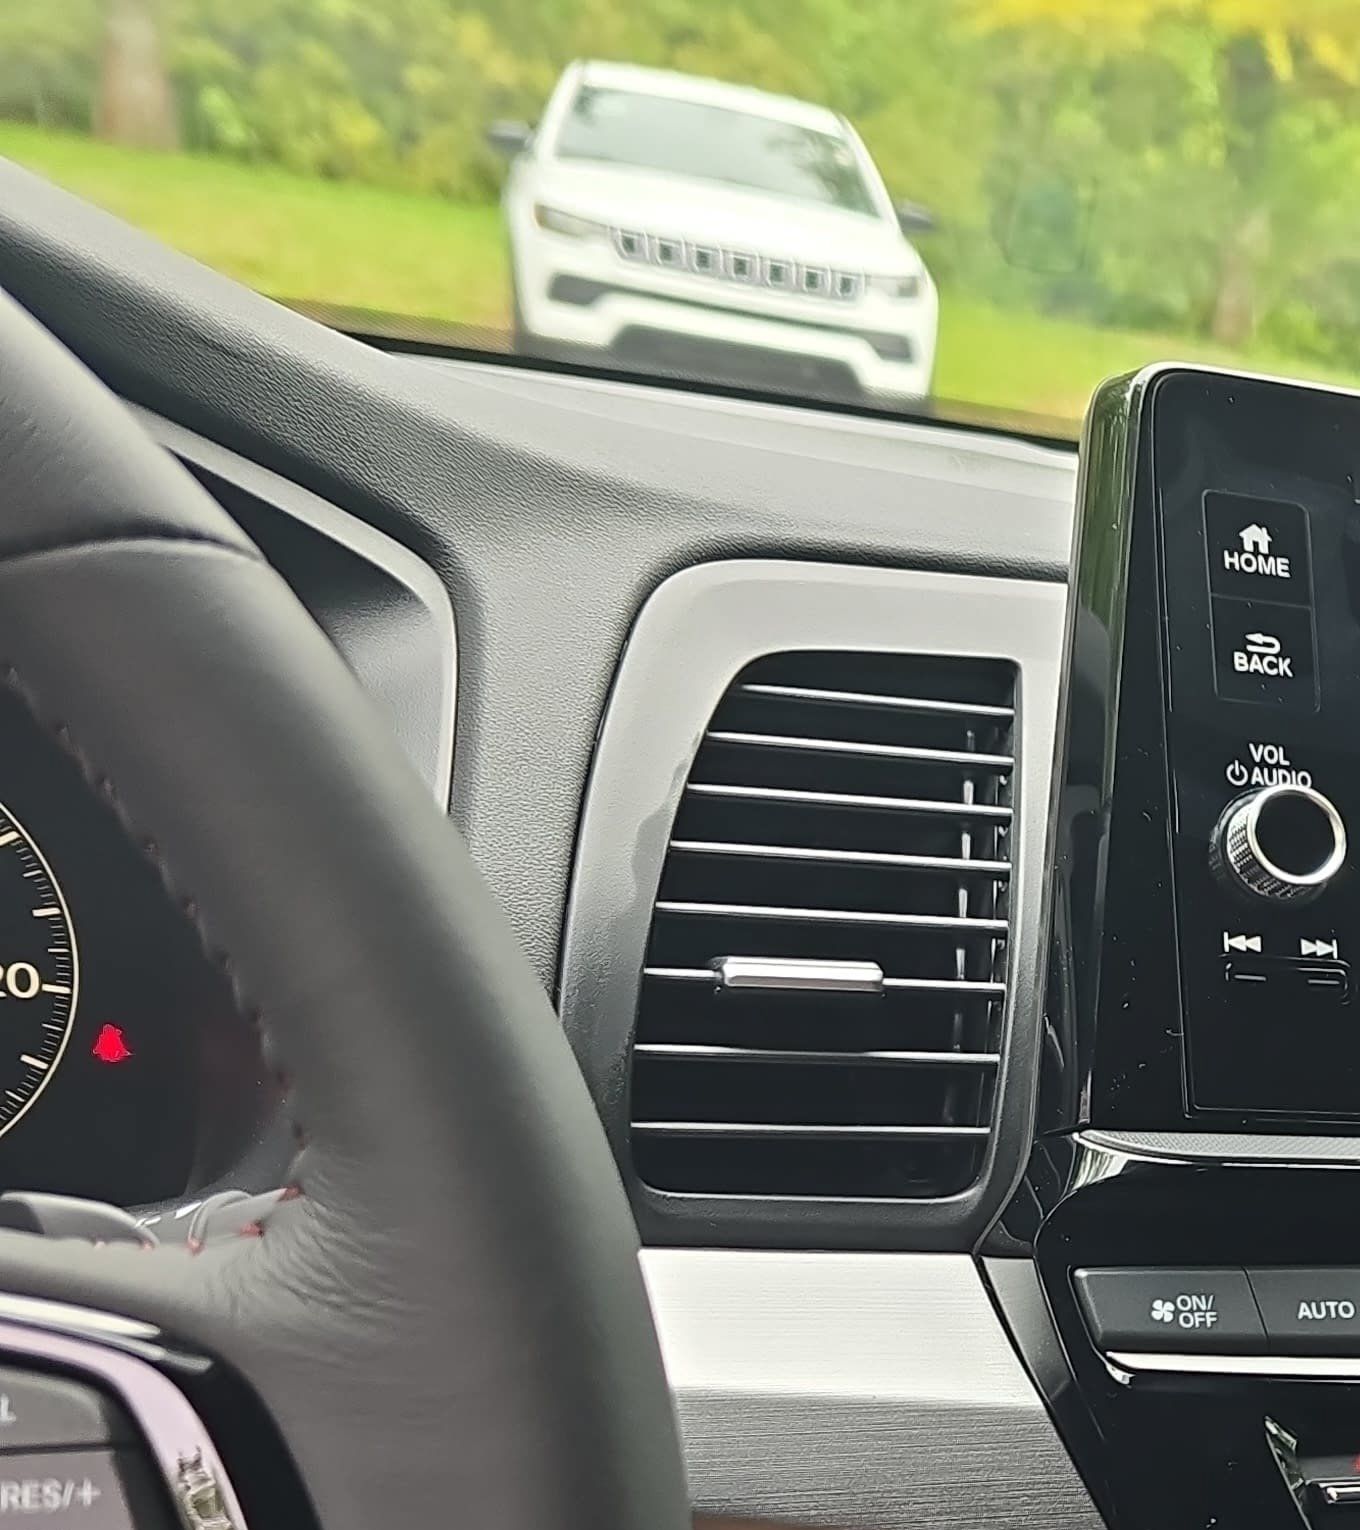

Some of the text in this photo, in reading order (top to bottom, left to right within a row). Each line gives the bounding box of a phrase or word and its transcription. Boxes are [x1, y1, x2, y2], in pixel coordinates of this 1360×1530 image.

[1224, 551, 1291, 579] HOME
[1233, 651, 1293, 679] BACK
[1249, 743, 1291, 767] VOL
[1250, 767, 1313, 790] AUDIO
[1176, 1294, 1214, 1311] ON/
[1297, 1300, 1355, 1321] AUTO
[1178, 1310, 1218, 1329] OFF
